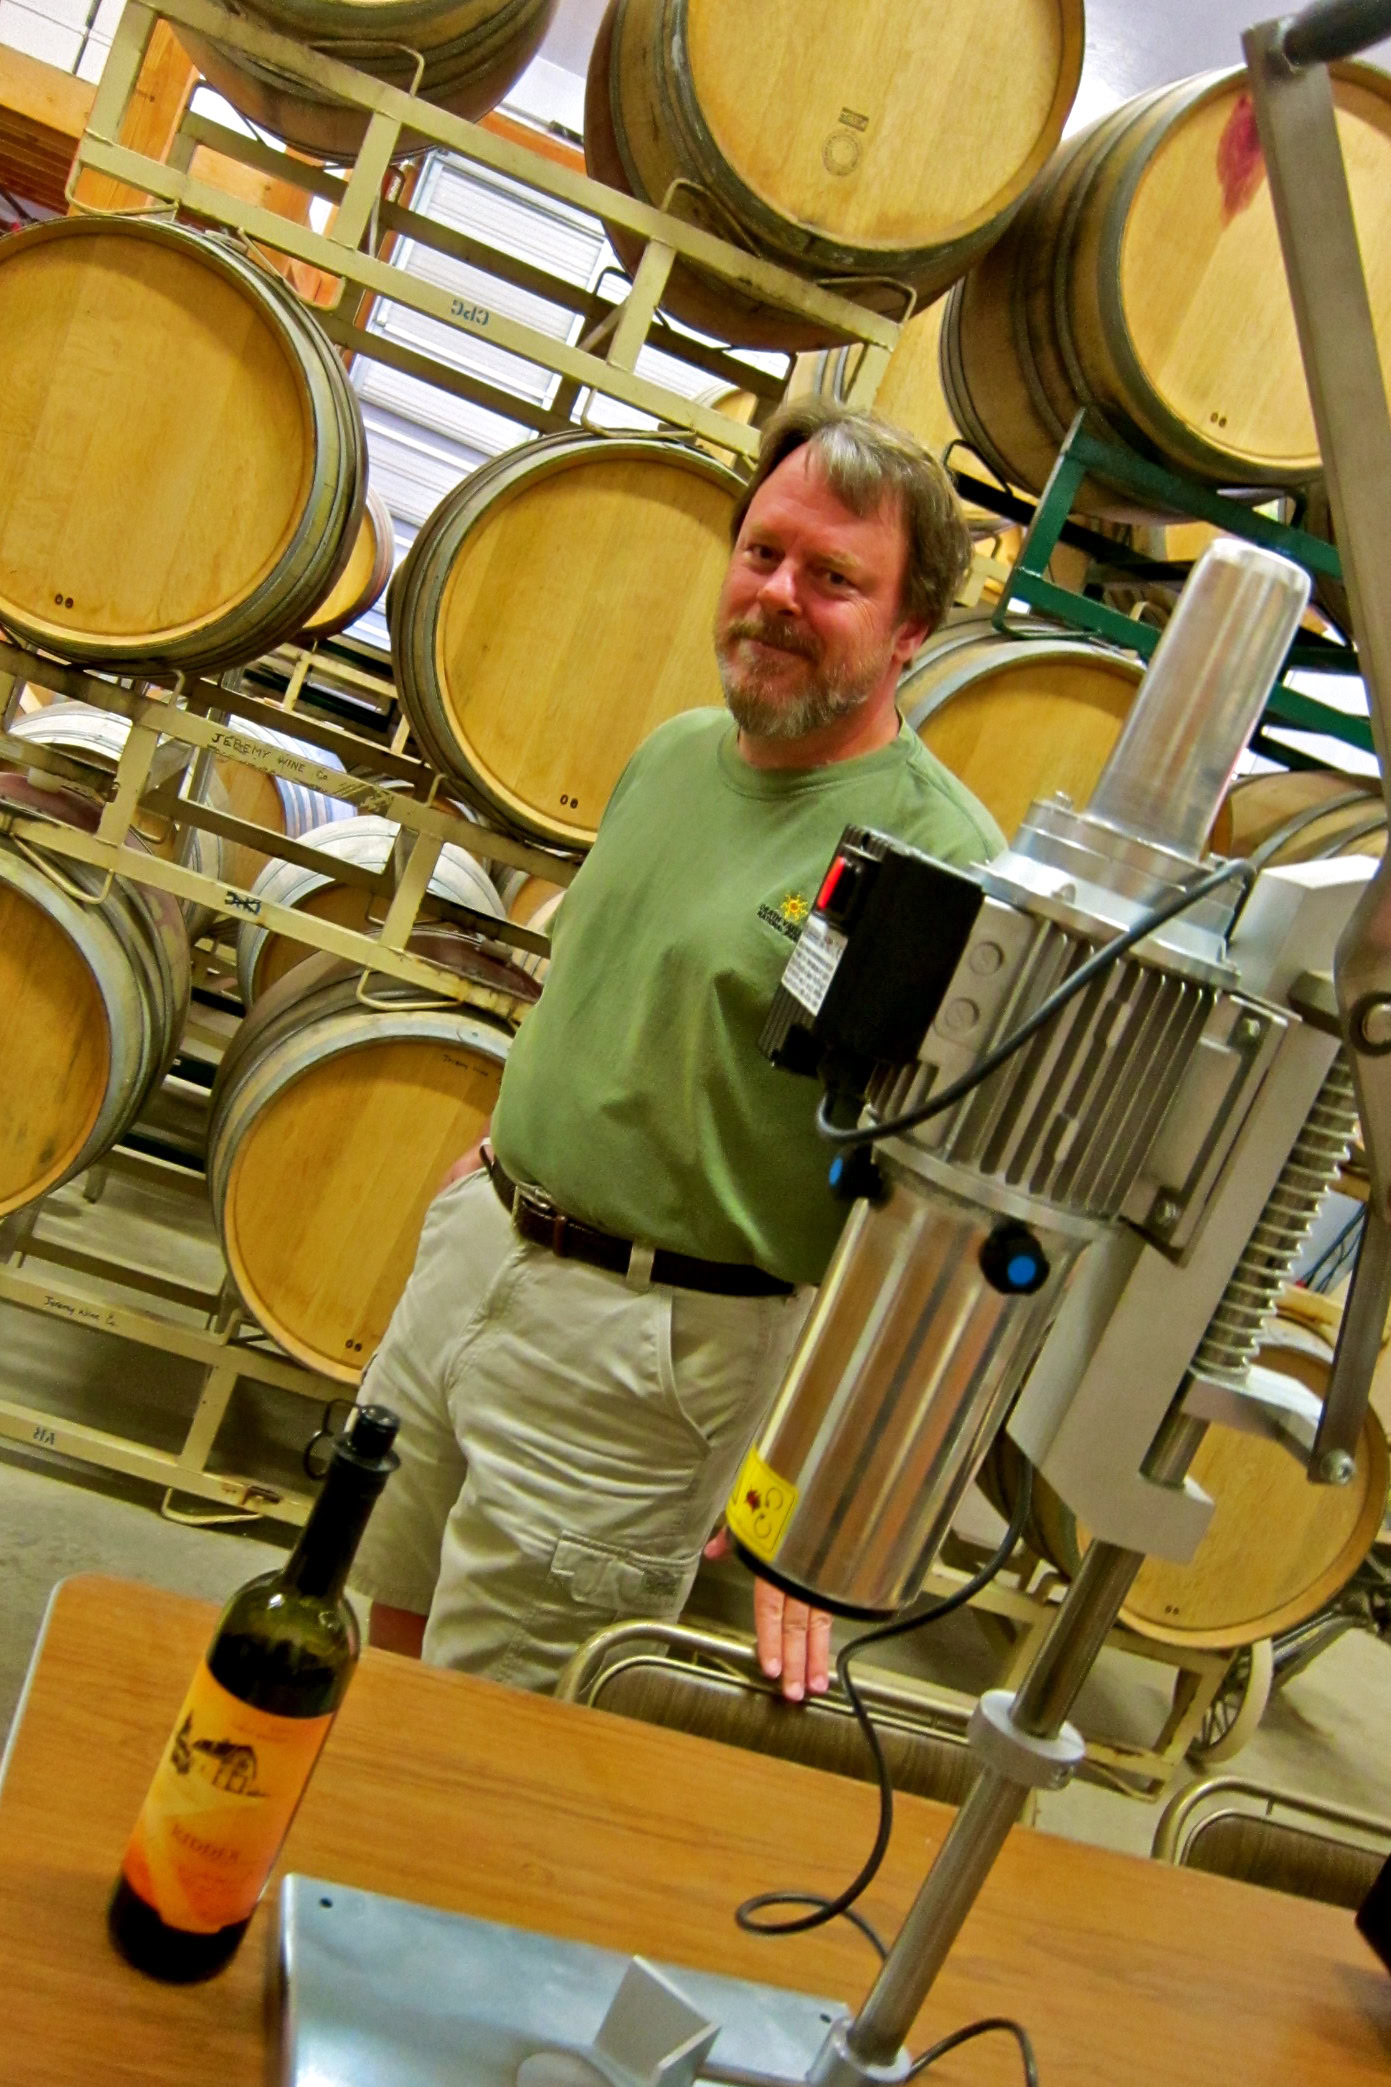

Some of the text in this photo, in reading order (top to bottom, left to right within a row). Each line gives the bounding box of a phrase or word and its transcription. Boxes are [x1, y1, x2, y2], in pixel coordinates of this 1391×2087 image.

[451, 299, 489, 325] CPC
[211, 732, 272, 759] JEREMY
[278, 757, 307, 773] WINE
